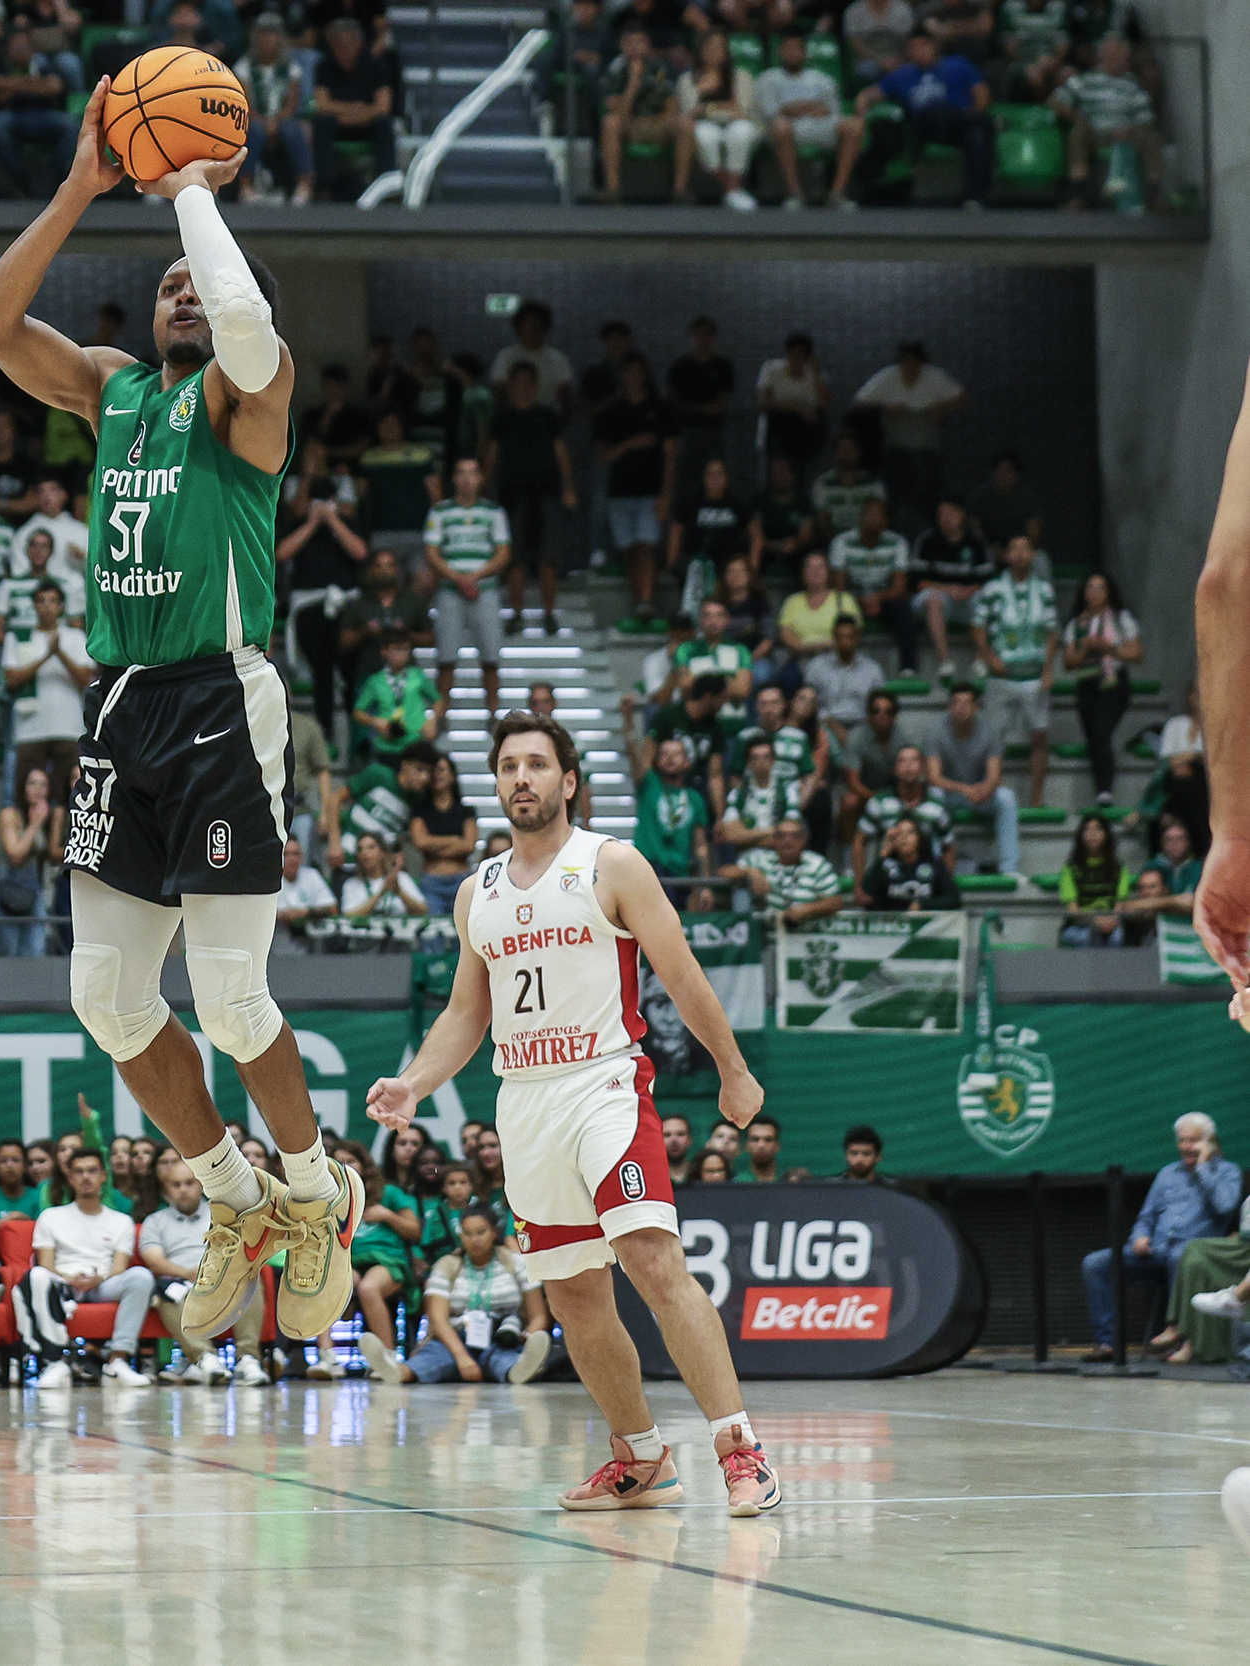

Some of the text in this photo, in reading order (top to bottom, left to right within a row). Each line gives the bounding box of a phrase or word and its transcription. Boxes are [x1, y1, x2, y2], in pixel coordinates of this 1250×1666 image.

[108, 501, 151, 564] 57
[74, 755, 118, 812] 57
[69, 809, 115, 834] TRAN
[68, 827, 110, 853] QUILI
[63, 846, 104, 873] DADE
[502, 926, 594, 956] BENFICA
[514, 966, 547, 1014] 21
[511, 1025, 582, 1042] conservas
[994, 1024, 1040, 1047] CP
[498, 1032, 602, 1070] RAMIREZ
[751, 1294, 880, 1331] Betclic
